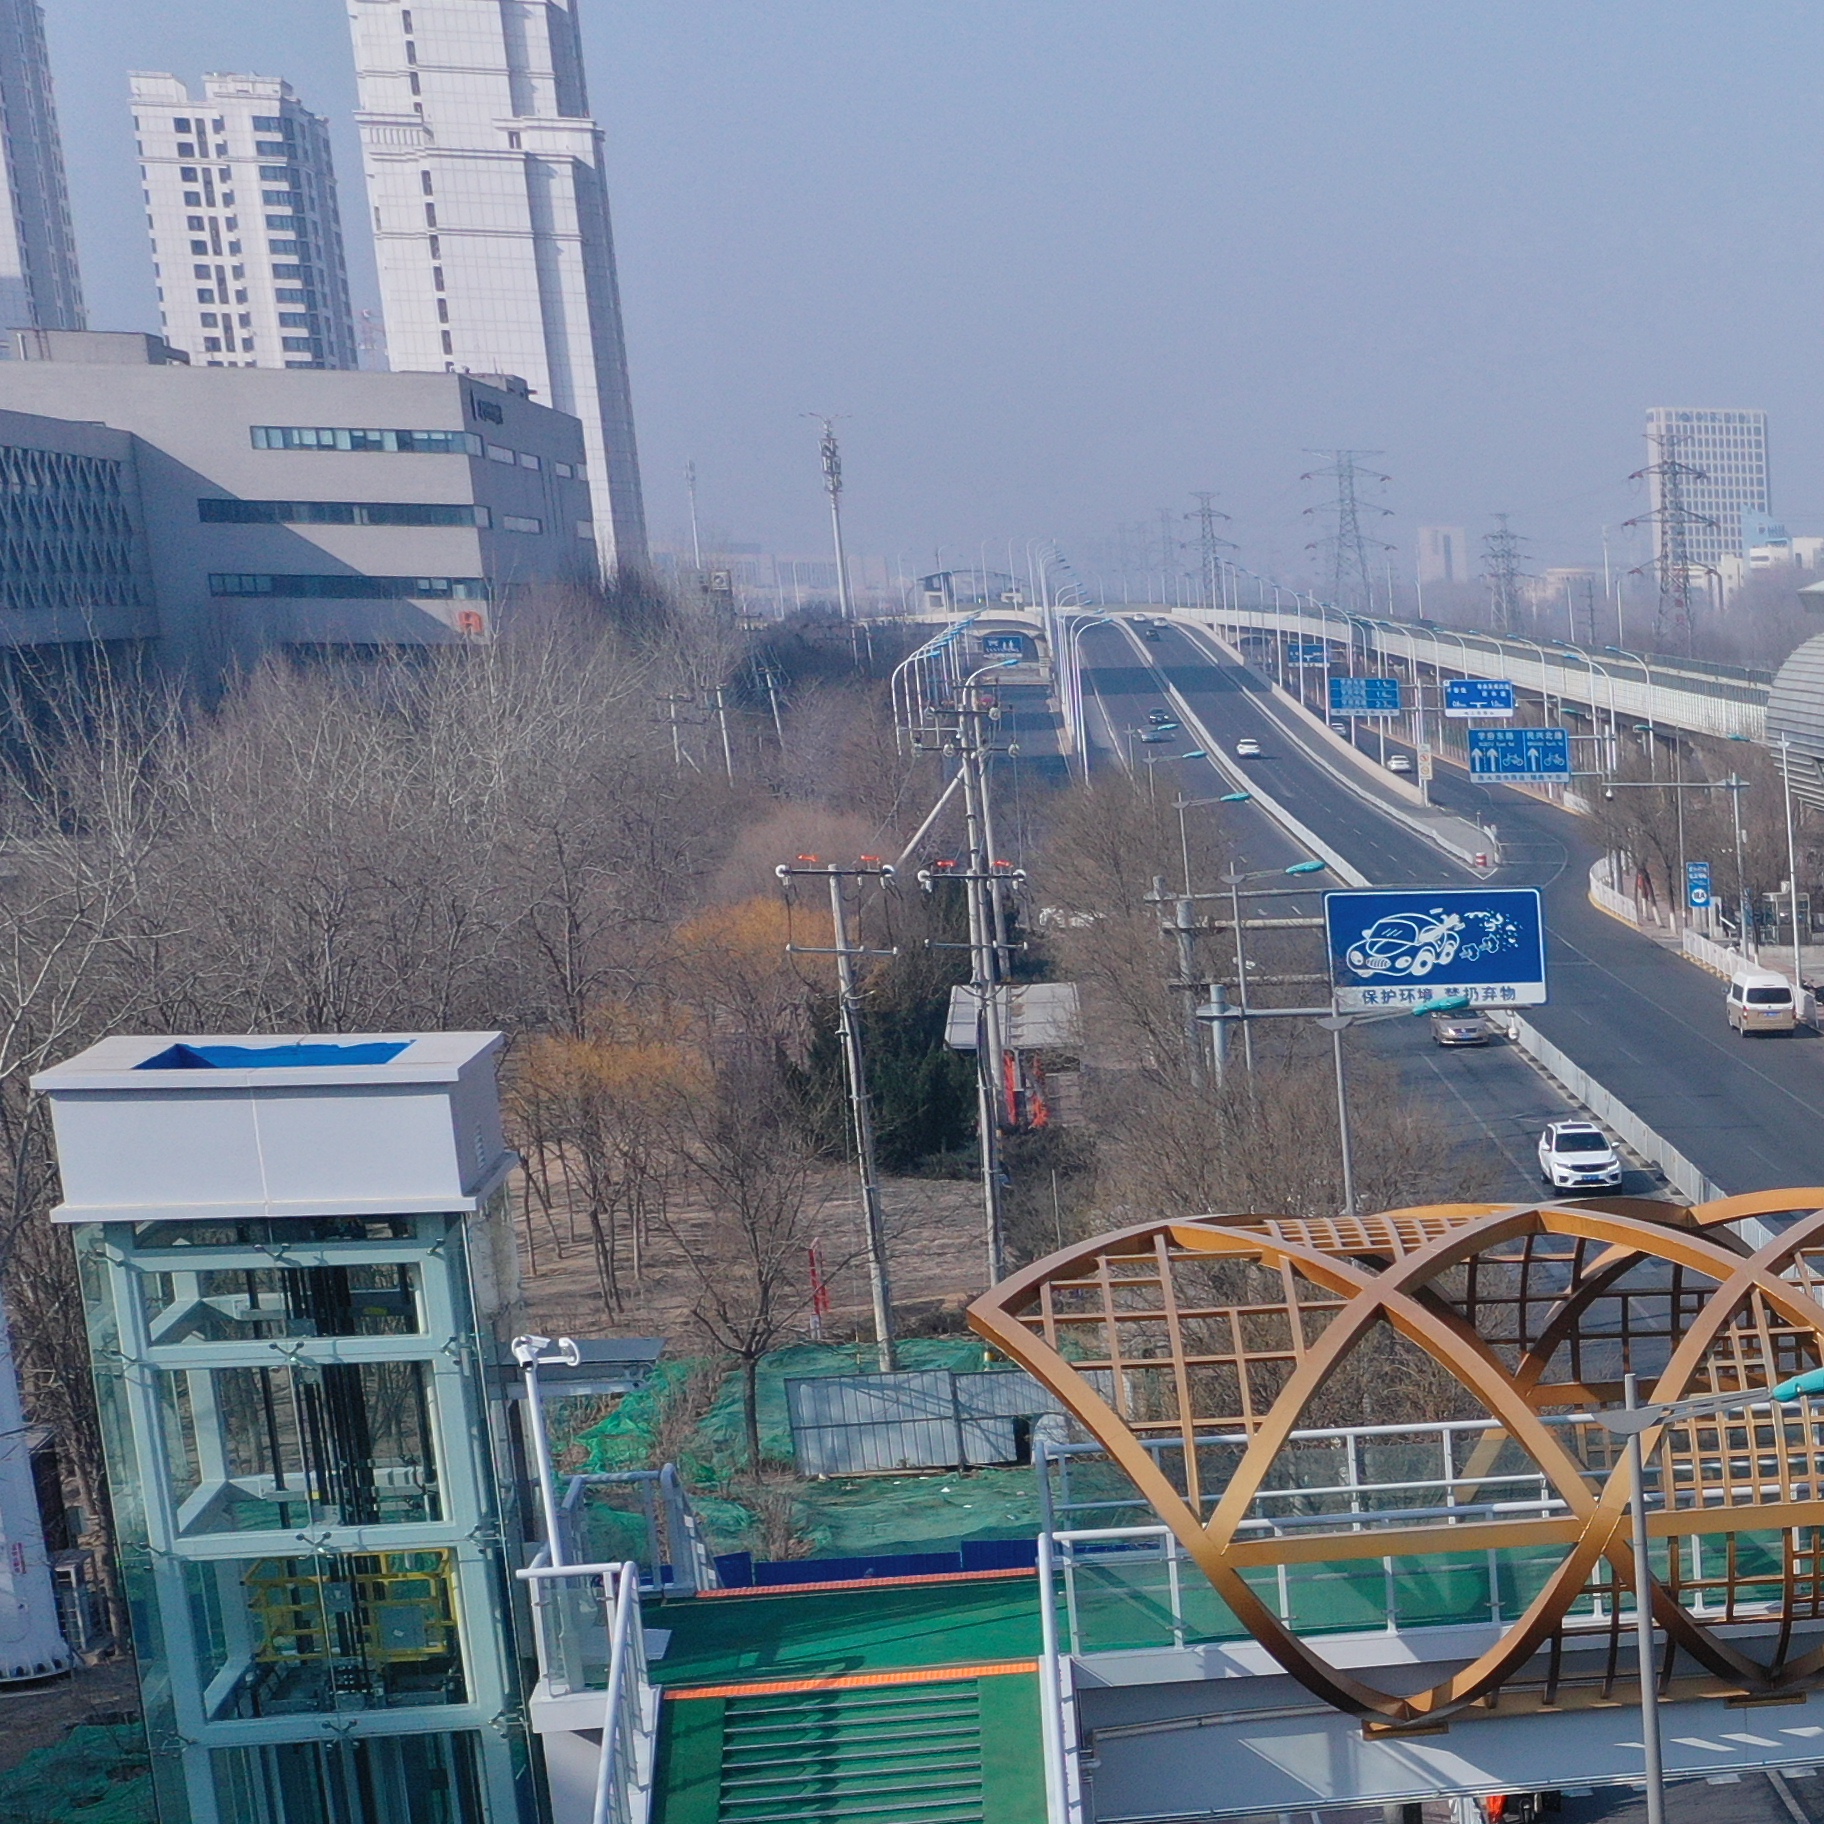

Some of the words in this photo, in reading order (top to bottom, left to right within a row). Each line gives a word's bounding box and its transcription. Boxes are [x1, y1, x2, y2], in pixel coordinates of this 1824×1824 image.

[1362, 987, 1433, 1005] 保护环境
[1444, 986, 1516, 1002] 禁扔弃物
